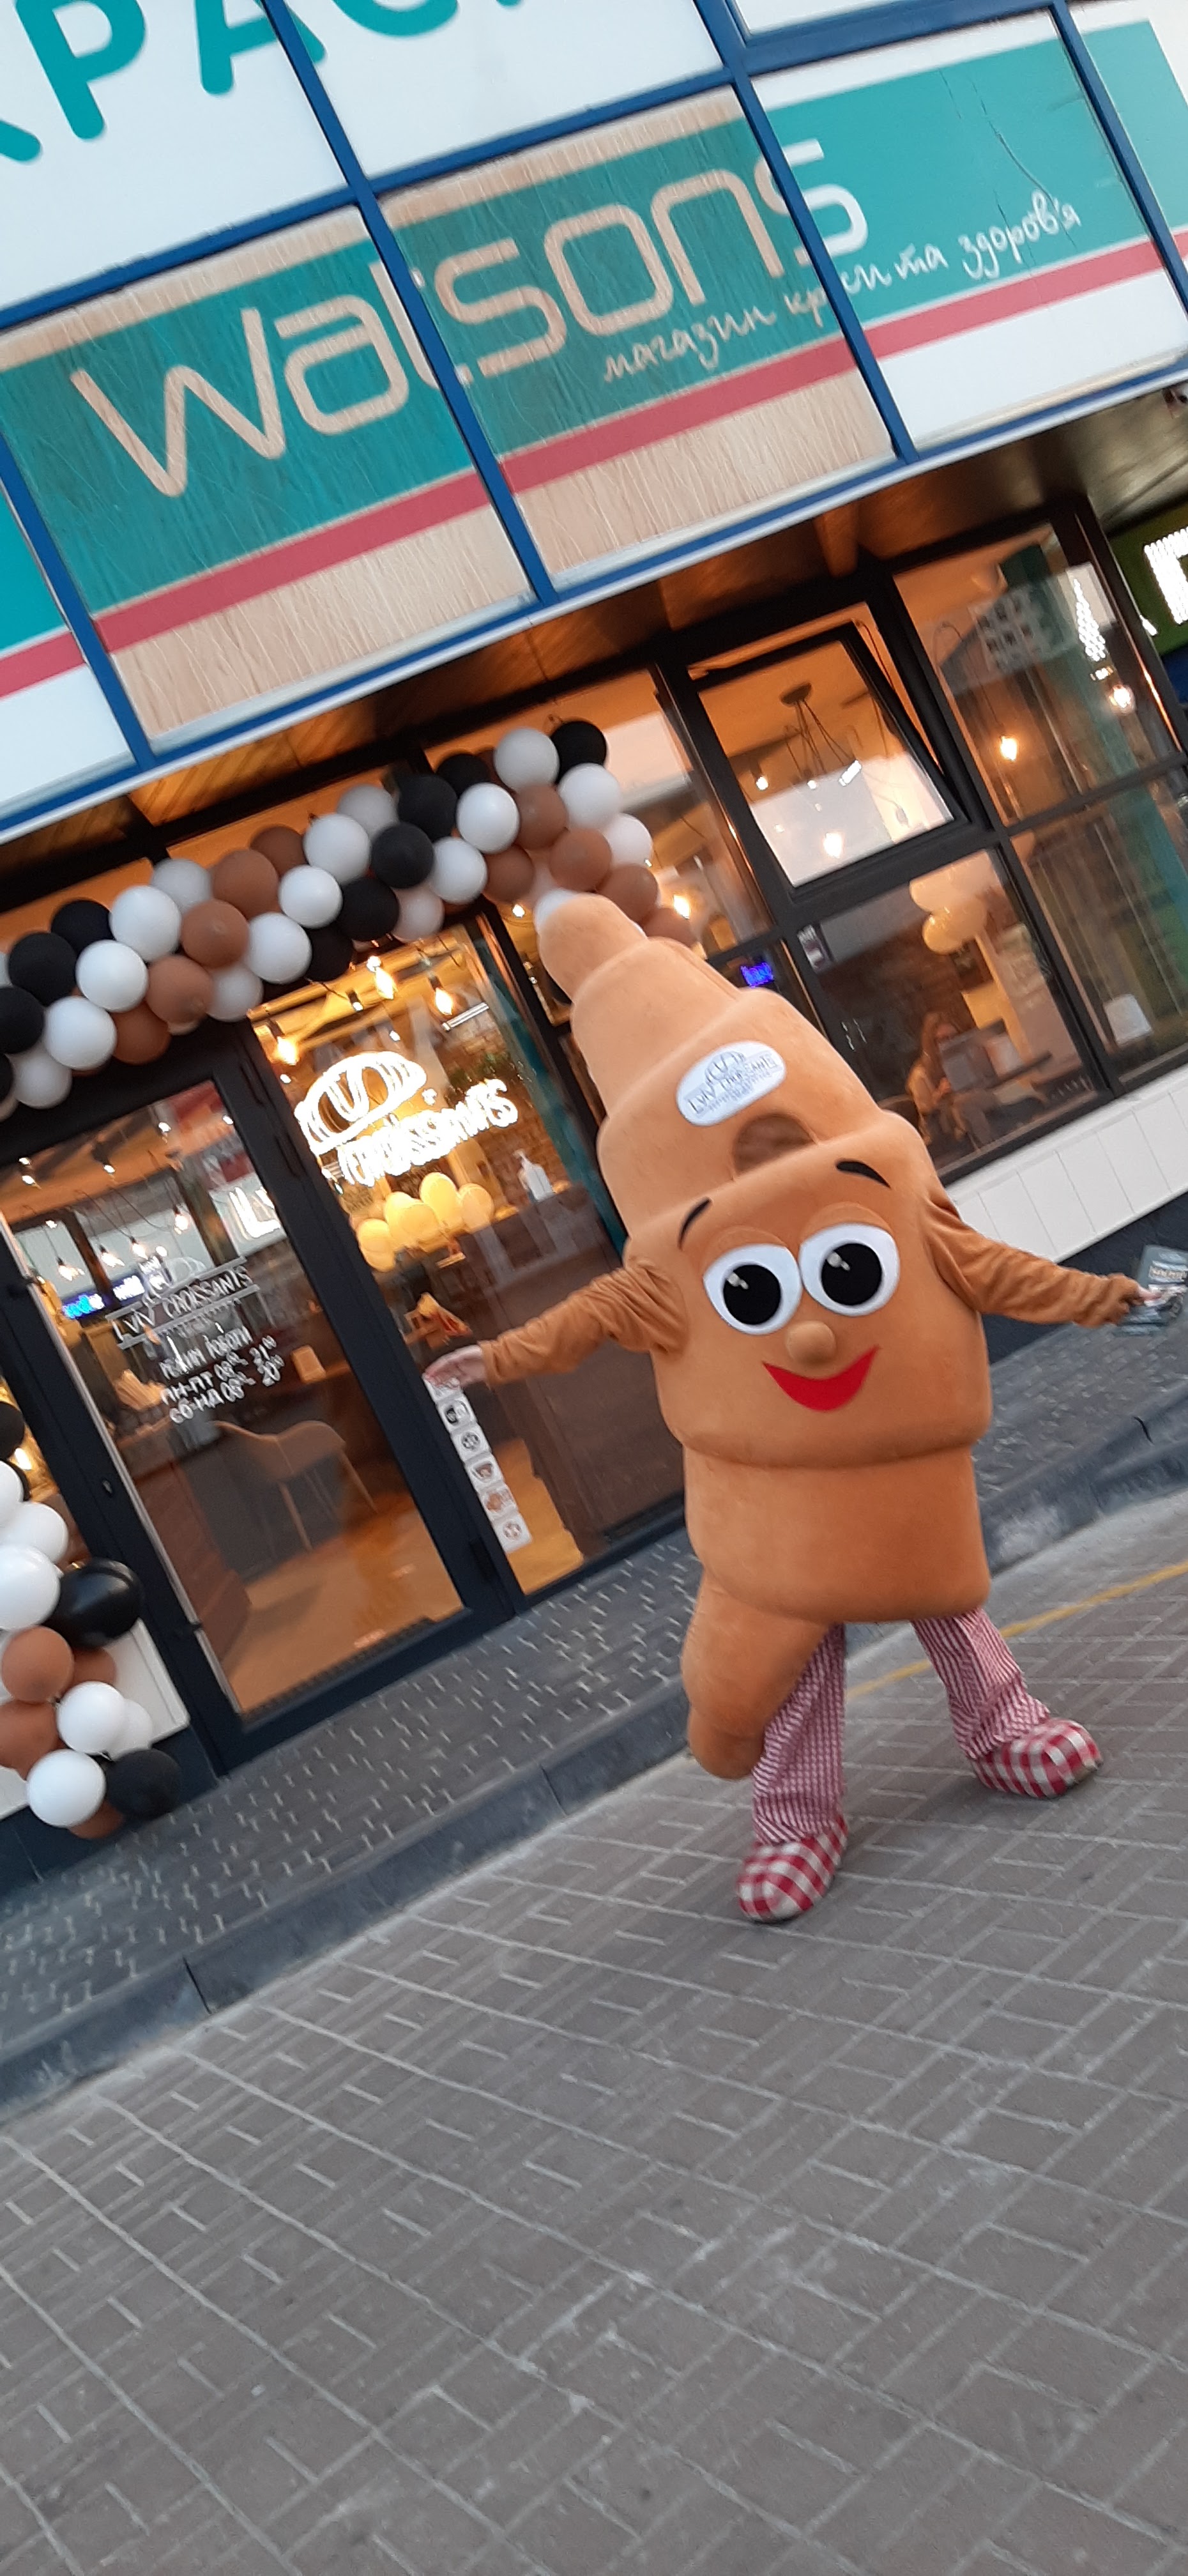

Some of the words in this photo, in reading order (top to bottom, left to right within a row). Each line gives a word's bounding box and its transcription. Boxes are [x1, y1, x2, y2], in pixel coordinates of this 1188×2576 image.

[604, 306, 776, 382] магазин
[784, 264, 892, 328] крси
[895, 244, 948, 281] та
[961, 189, 1081, 280] здоров'я
